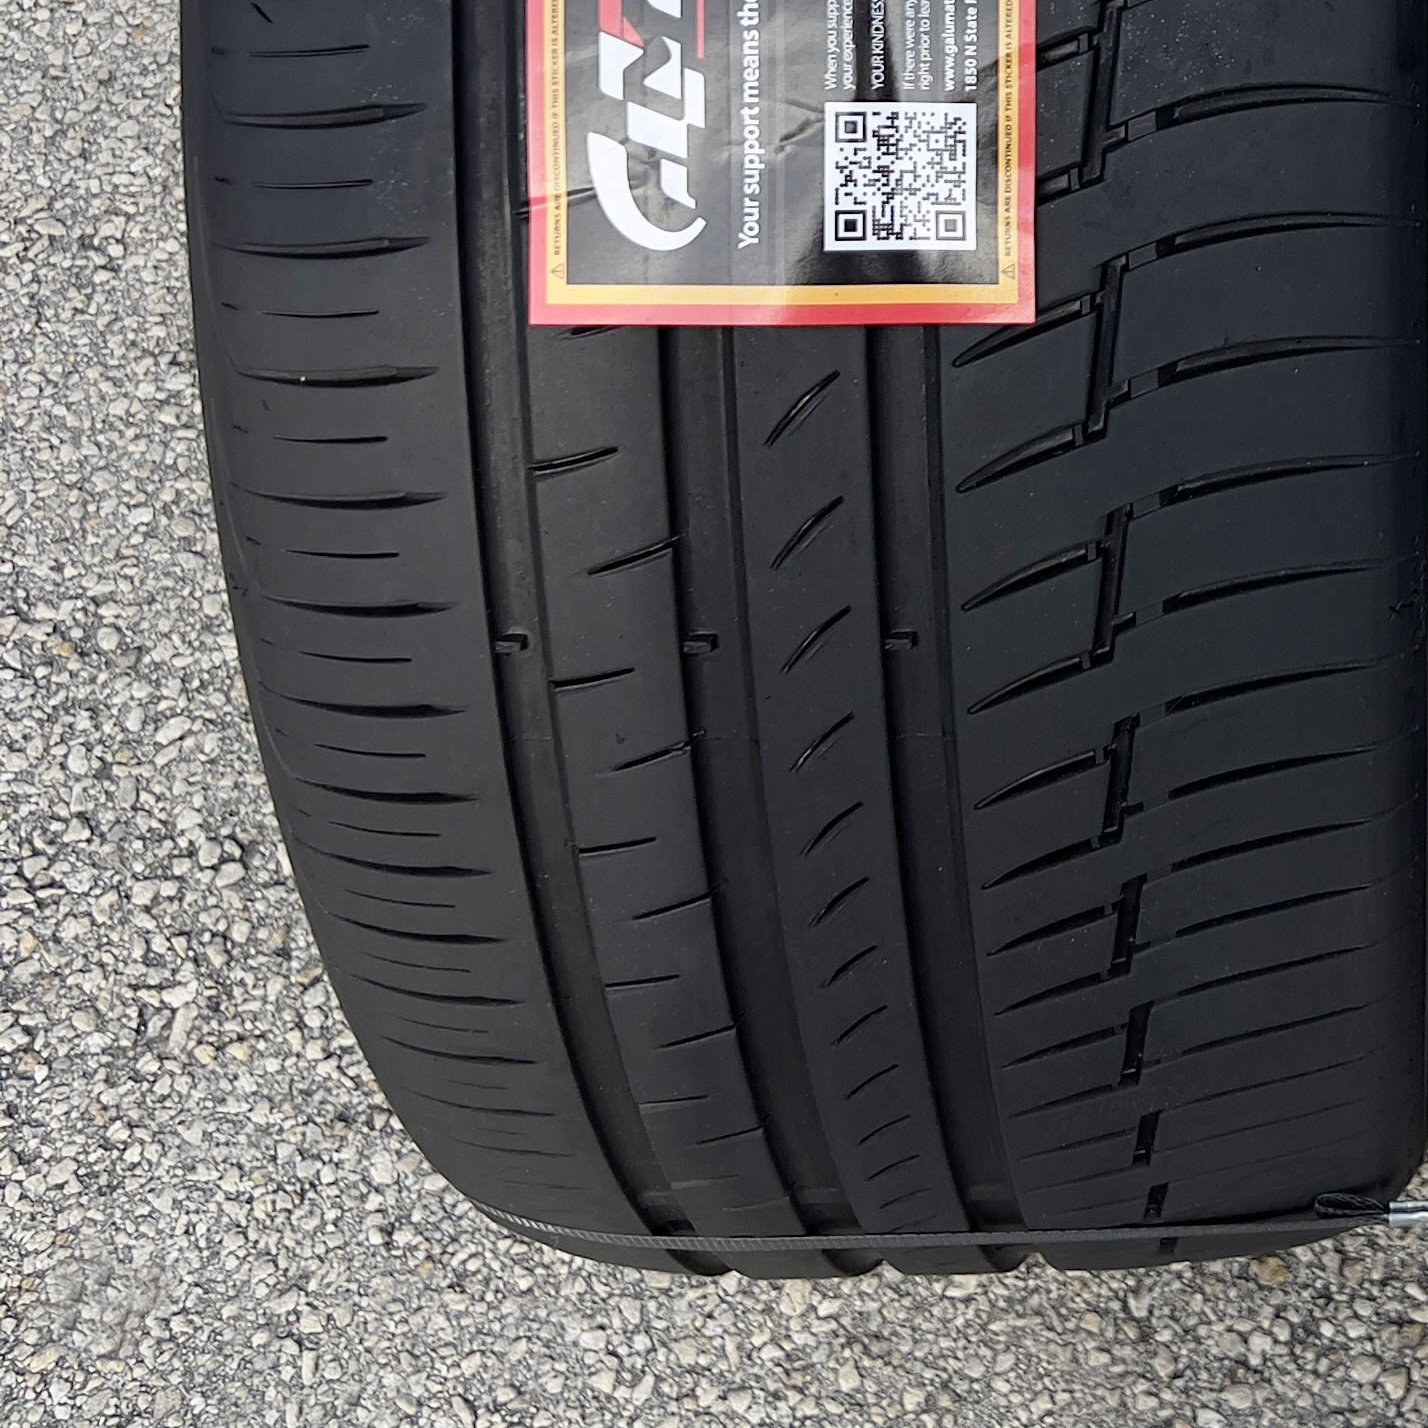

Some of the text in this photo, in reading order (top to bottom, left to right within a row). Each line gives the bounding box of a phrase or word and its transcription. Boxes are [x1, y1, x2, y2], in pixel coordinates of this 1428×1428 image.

[905, 19, 916, 49] were
[918, 18, 931, 32] to
[964, 6, 978, 42] State
[828, 30, 841, 53] you
[918, 33, 934, 61] prior
[964, 45, 978, 56] N
[743, 29, 761, 103] means
[825, 54, 838, 90] When
[843, 62, 856, 90] your
[872, 55, 885, 90] YOUR
[903, 50, 916, 80] there
[918, 62, 934, 90] right
[964, 58, 978, 91] 1850
[738, 106, 765, 195] support
[738, 196, 760, 249] Your
